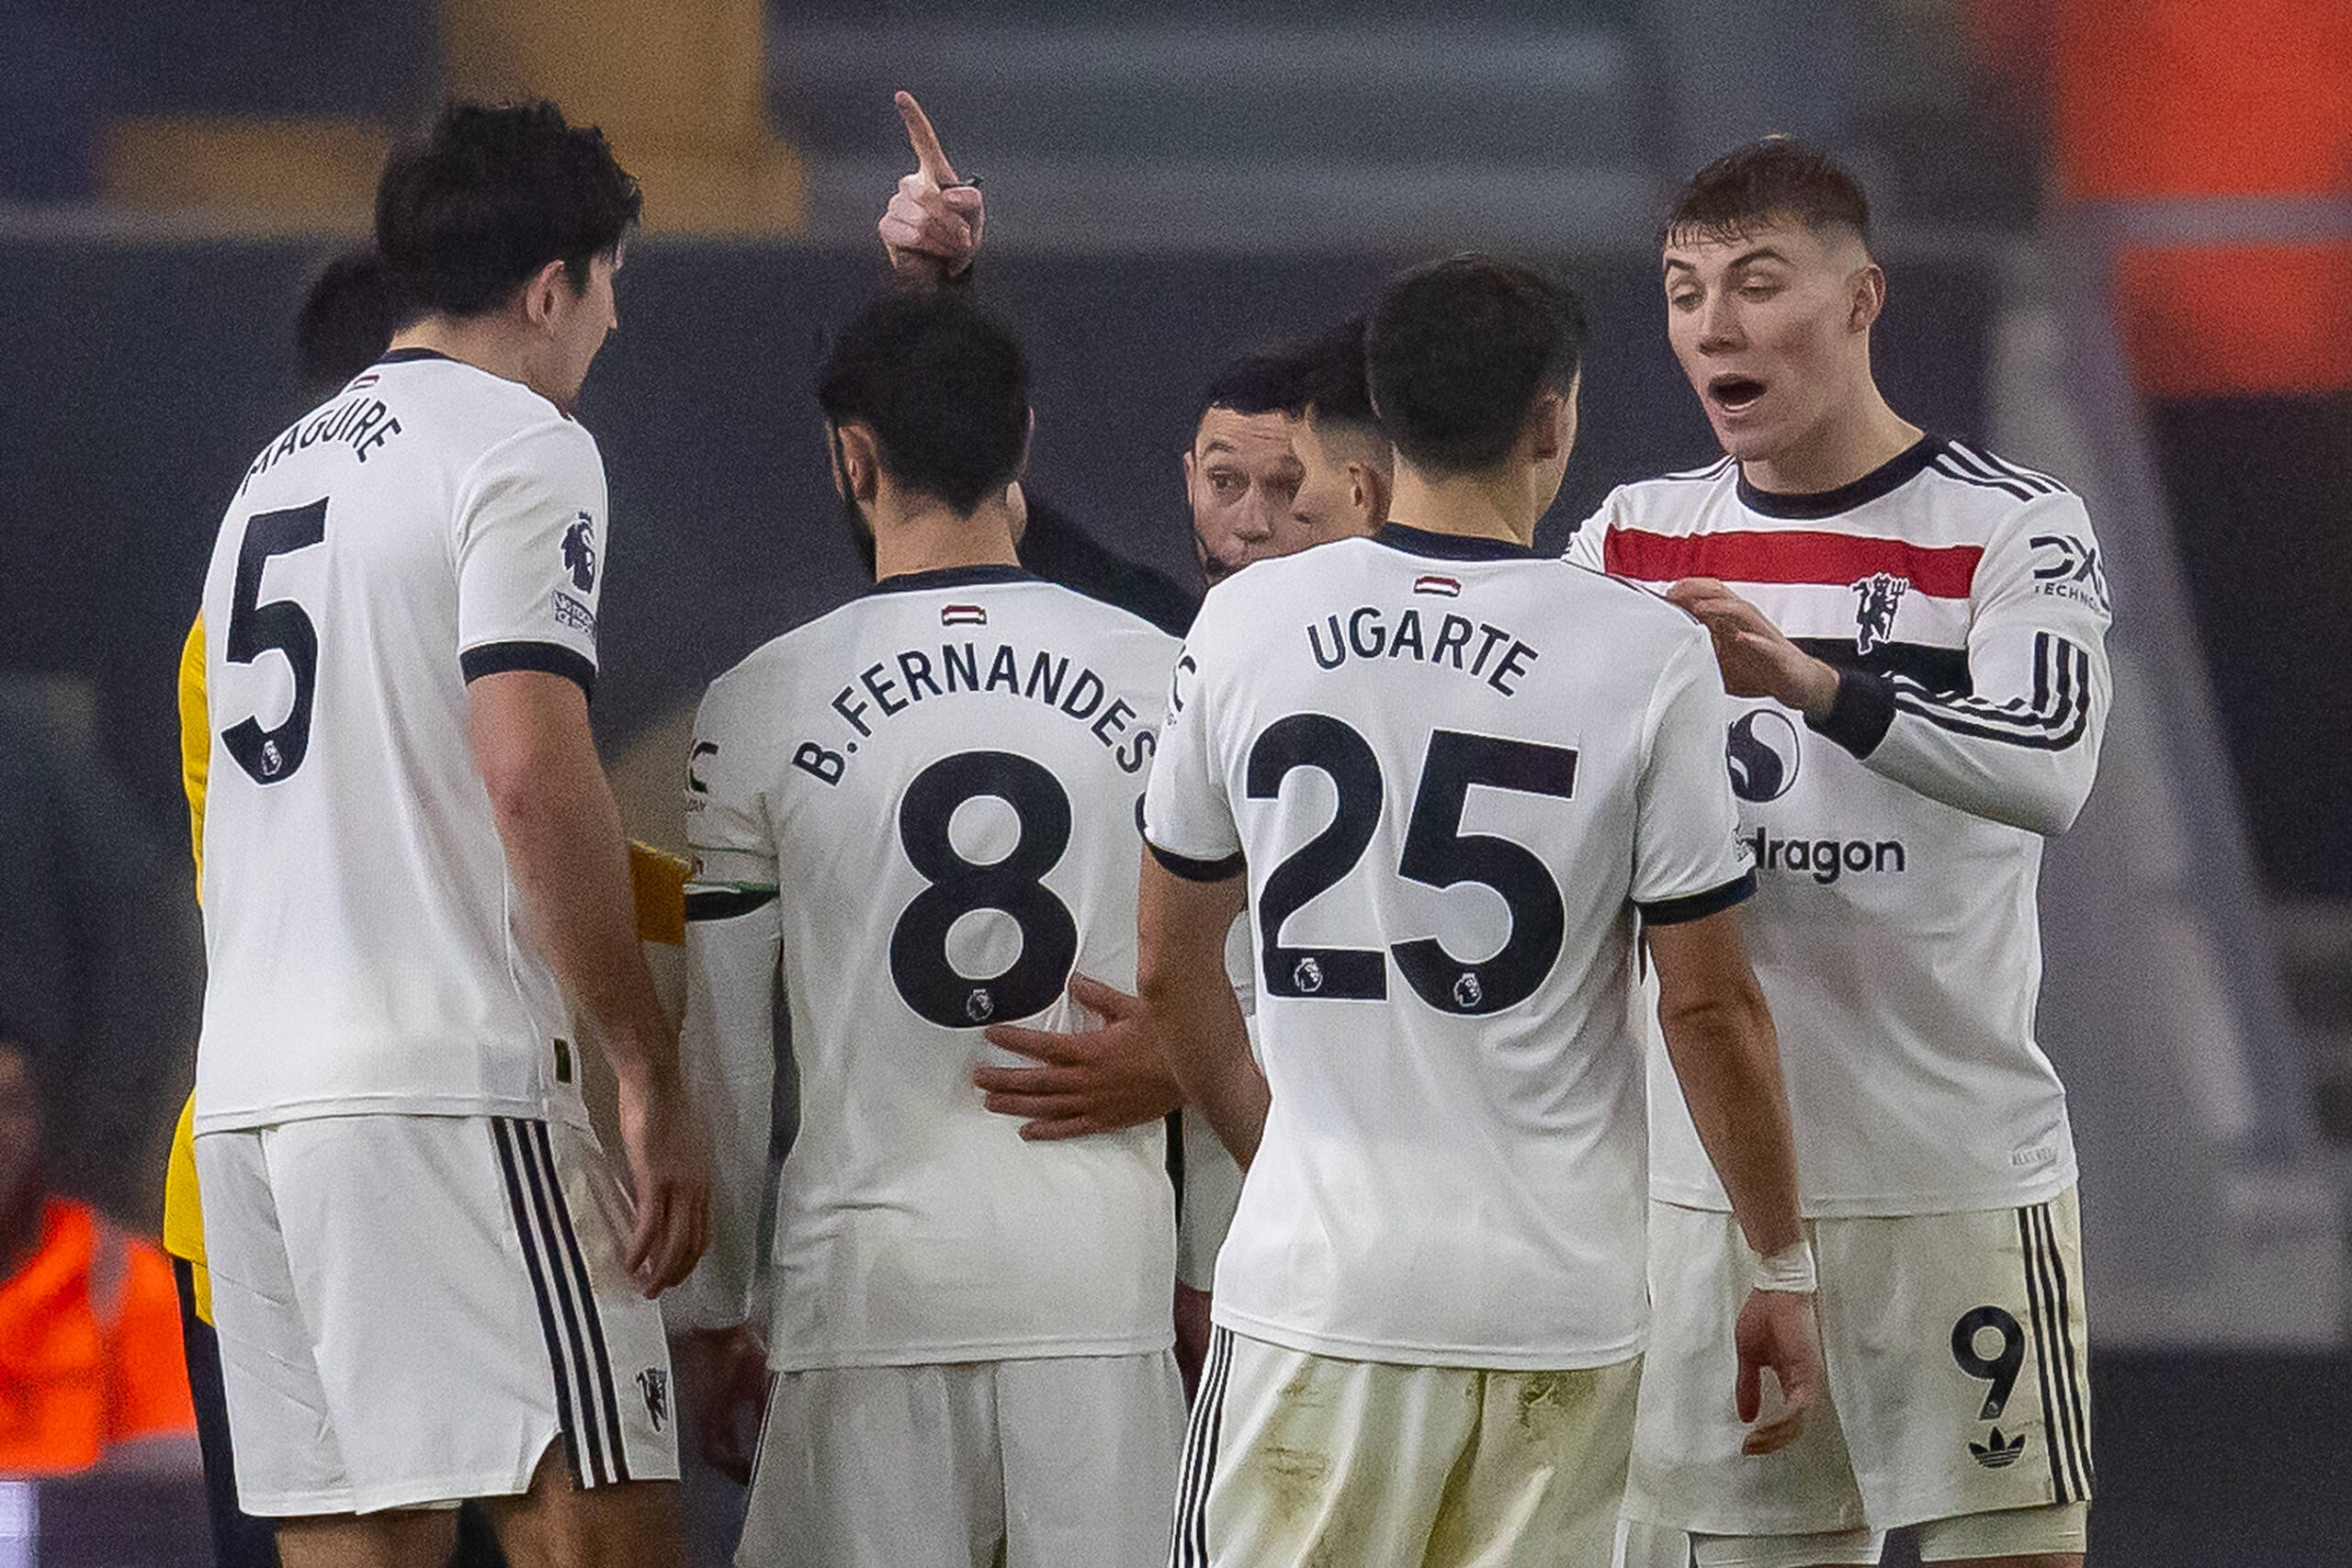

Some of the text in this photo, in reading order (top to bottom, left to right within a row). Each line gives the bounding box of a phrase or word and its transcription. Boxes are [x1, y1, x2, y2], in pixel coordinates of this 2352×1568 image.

[241, 397, 402, 498] MAGUIRE
[220, 495, 330, 785] 5
[1306, 606, 1539, 697] UGARTE
[792, 642, 1157, 787] B.FERNANDES
[889, 750, 1079, 1029] 8
[1246, 713, 1579, 1018] 25
[1951, 1304, 2026, 1422] 9
